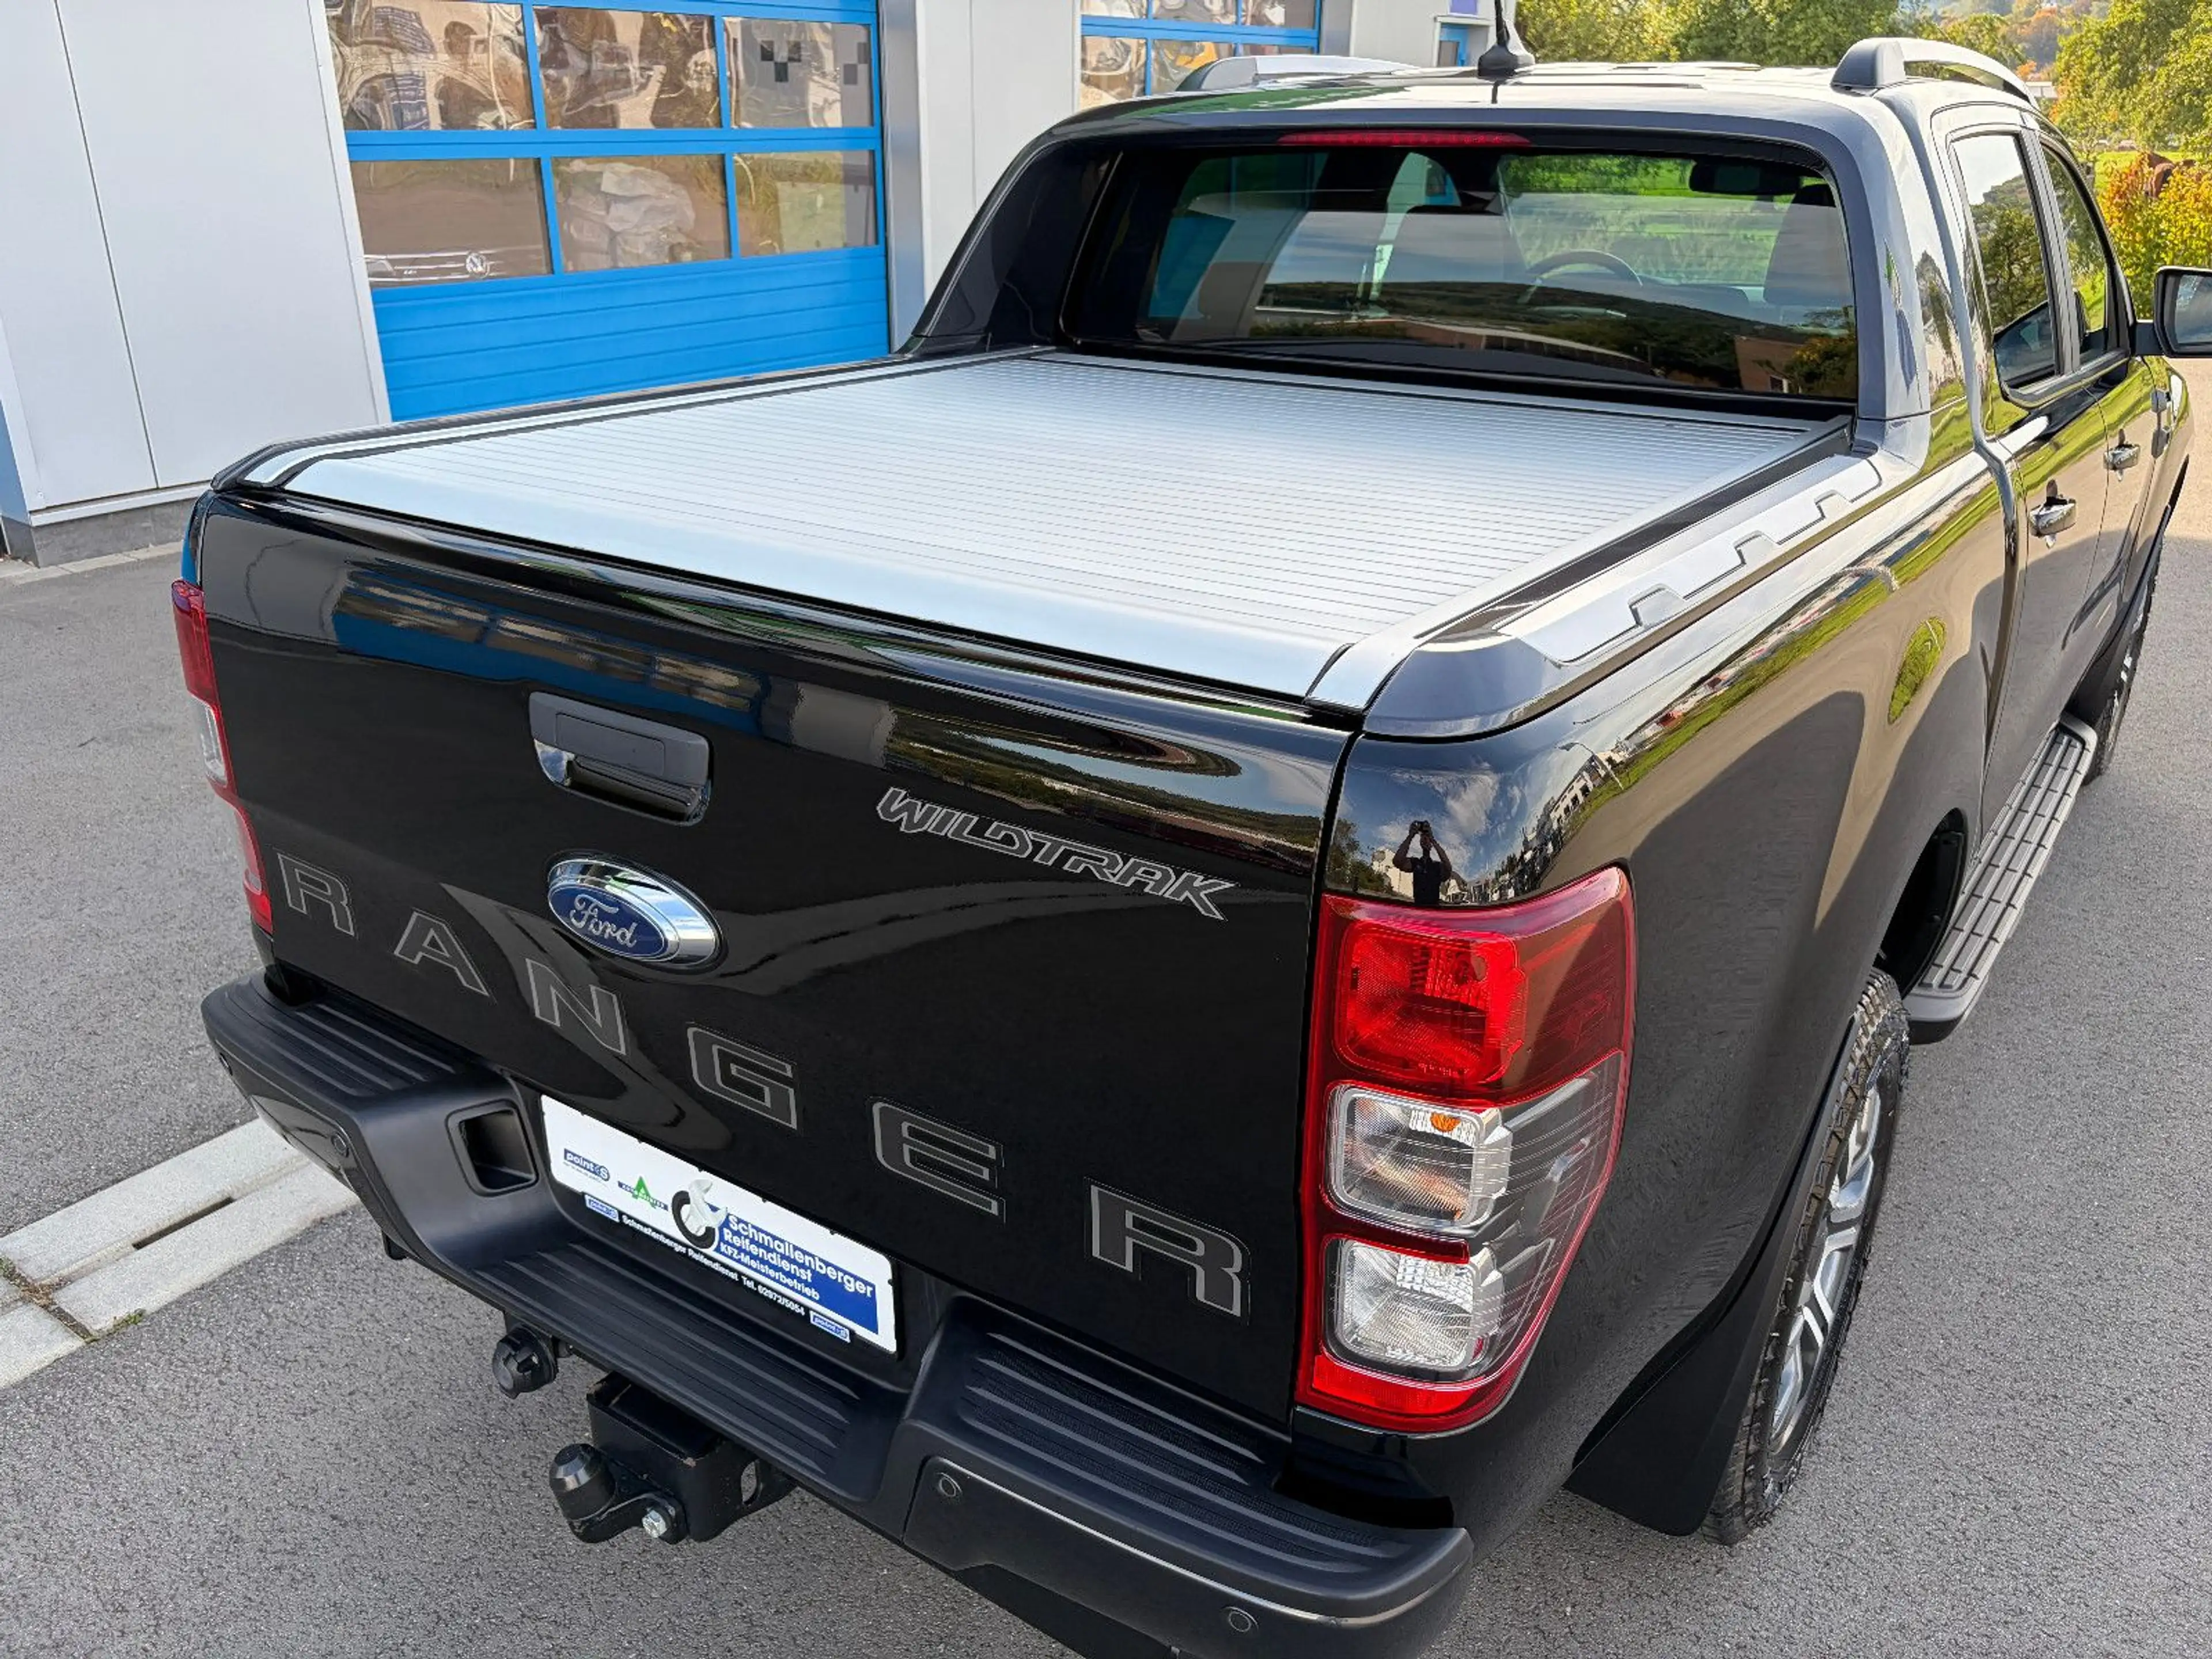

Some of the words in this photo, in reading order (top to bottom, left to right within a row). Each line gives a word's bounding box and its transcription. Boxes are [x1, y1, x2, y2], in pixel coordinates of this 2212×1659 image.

[876, 786, 1236, 921] WILDTRAK
[569, 893, 638, 948] Ford
[277, 853, 1244, 1318] RANGER
[719, 1241, 820, 1301] KFZ-Meisterbetrieb
[723, 1228, 813, 1282] Reifendienst
[728, 1215, 873, 1298] Schmallenberger
[741, 1275, 757, 1291] Tel.
